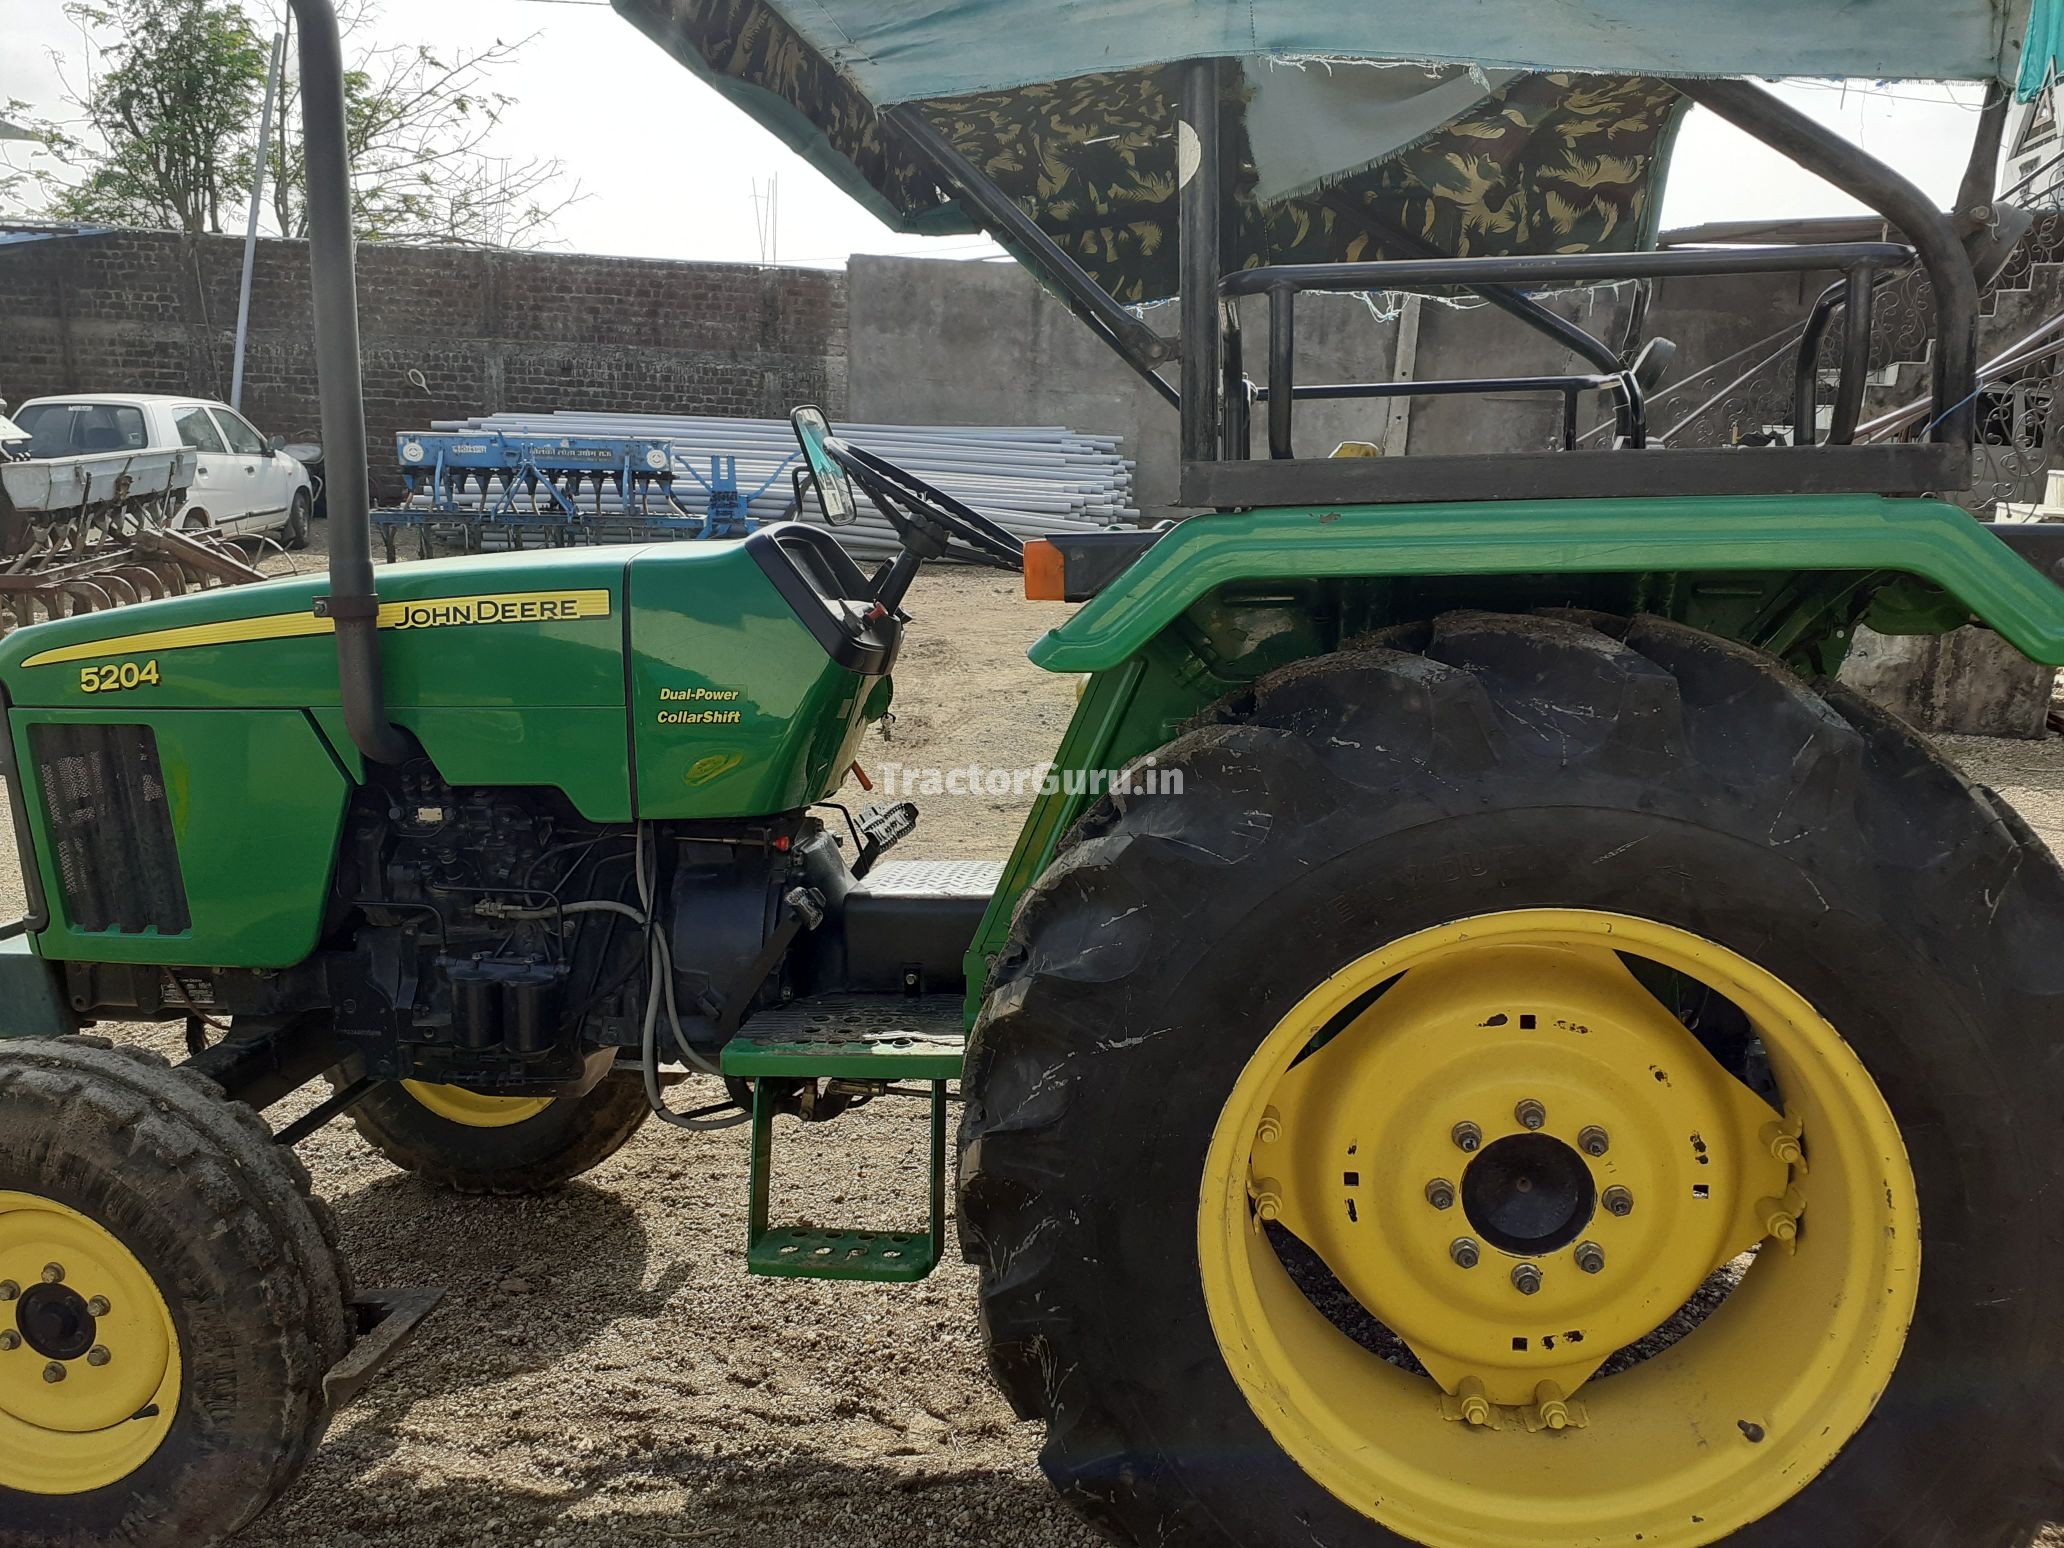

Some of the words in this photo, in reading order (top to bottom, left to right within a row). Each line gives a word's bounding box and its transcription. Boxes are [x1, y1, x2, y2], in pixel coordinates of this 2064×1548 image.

[394, 605, 471, 627] JOHN
[476, 599, 578, 621] DEERE
[80, 659, 160, 692] 5204
[660, 687, 739, 701] Dual-Power
[657, 710, 741, 724] CollarShift
